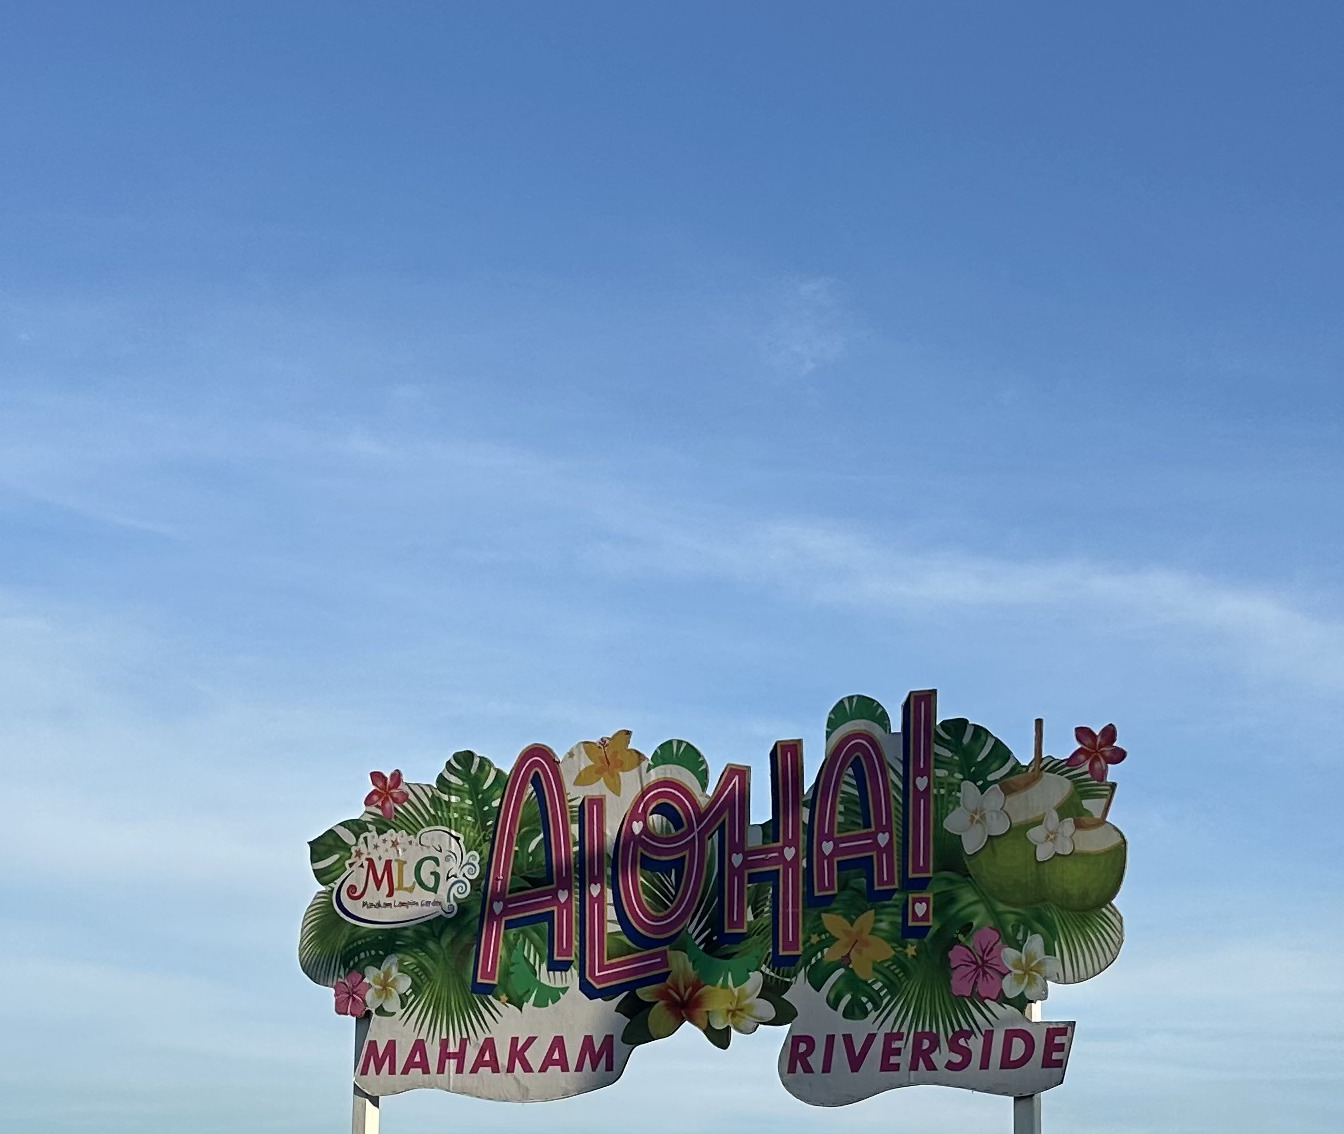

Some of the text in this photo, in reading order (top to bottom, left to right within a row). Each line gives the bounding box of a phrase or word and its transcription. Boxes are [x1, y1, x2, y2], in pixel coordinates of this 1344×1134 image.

[472, 689, 937, 1000] ALOHA!
[346, 855, 441, 901] MLG
[360, 1034, 614, 1076] MAHAKAM
[787, 1027, 1069, 1075] RIVERSIDE
